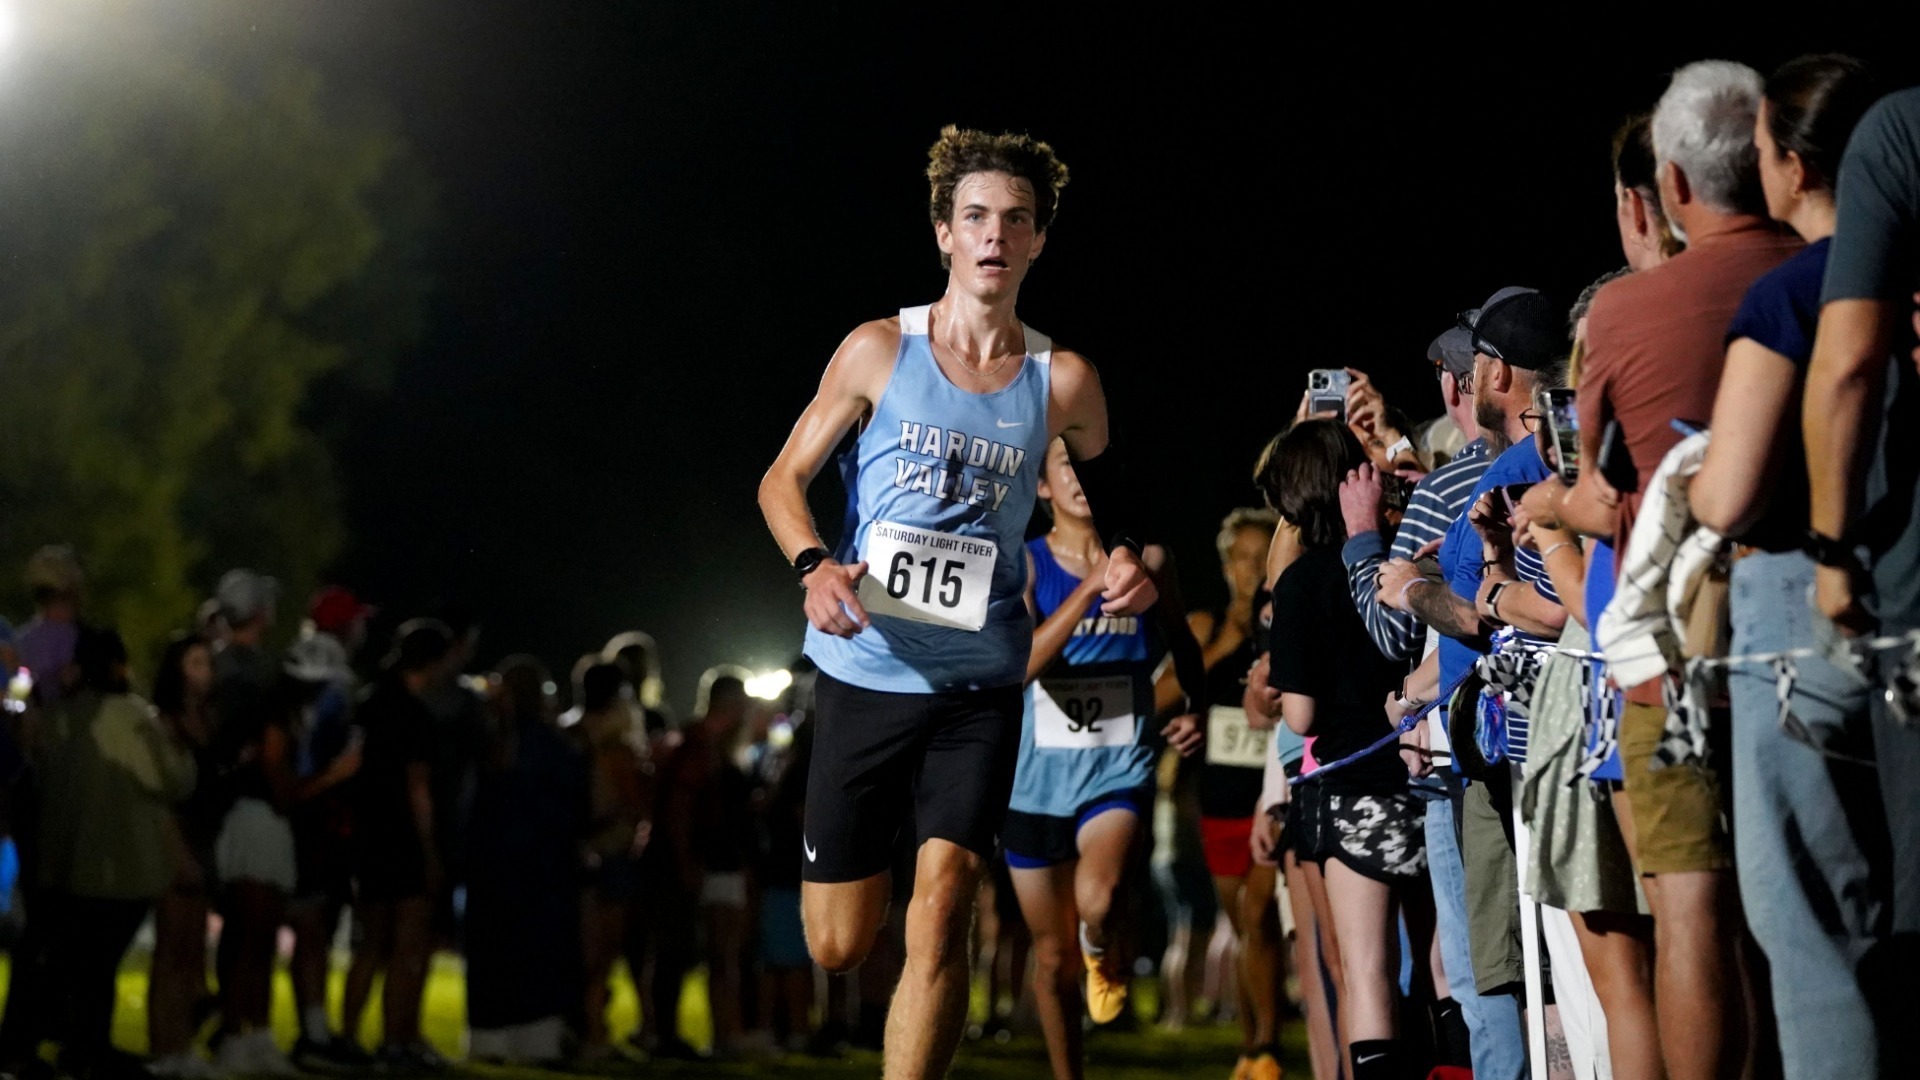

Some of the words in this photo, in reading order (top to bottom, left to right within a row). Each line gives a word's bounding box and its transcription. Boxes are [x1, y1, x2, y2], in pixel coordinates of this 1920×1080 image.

[899, 420, 1025, 477] HARDIN
[894, 456, 1011, 512] VALLEY
[876, 526, 929, 546] SATURDAY
[930, 536, 960, 551] LIGHT
[961, 541, 993, 557] FEVER
[886, 551, 966, 608] 615
[1067, 697, 1102, 732] 92
